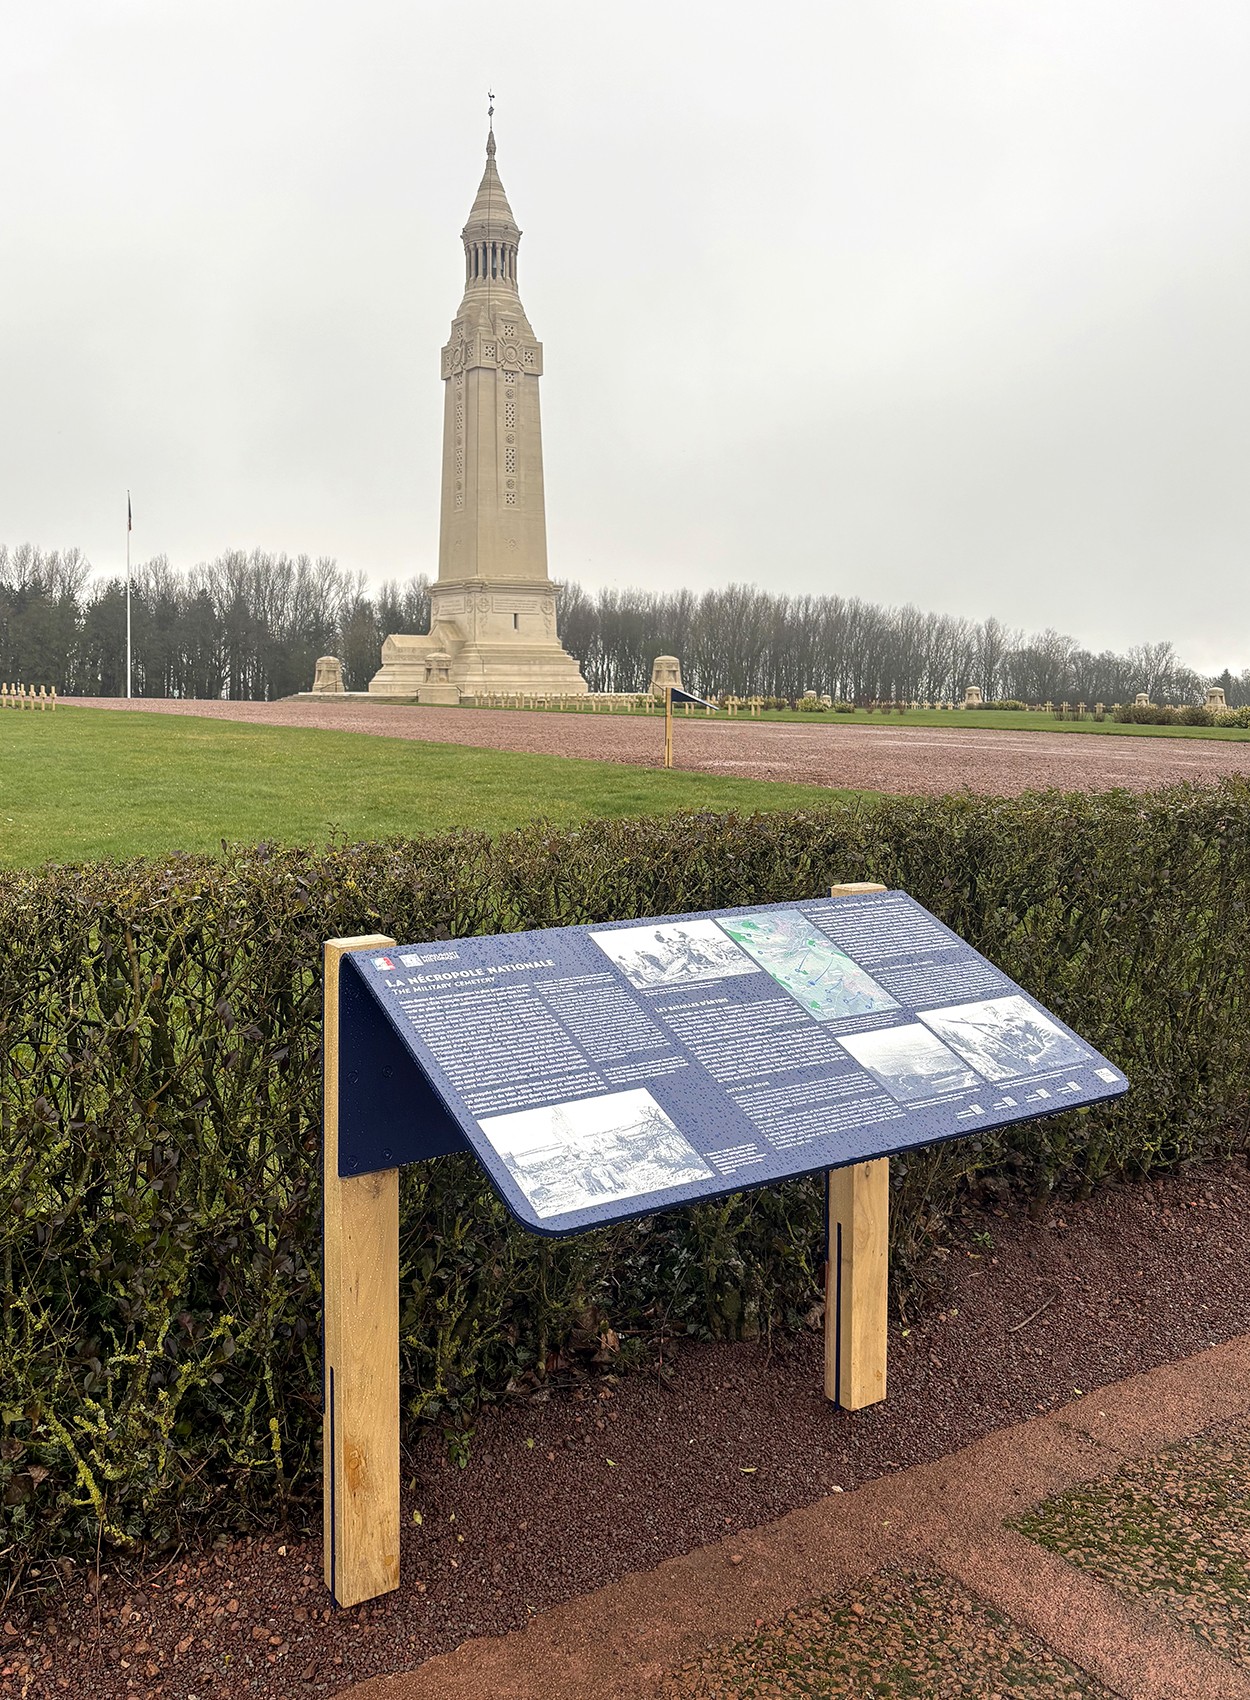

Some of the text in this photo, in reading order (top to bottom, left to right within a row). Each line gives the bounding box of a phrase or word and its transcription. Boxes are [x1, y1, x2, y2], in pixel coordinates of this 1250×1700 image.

[385, 959, 556, 988] LA NÉCROPOLE NATIONALE
[392, 976, 496, 996] THE MILITARY CEMETERY
[668, 1002, 699, 1011] BATAILLES
